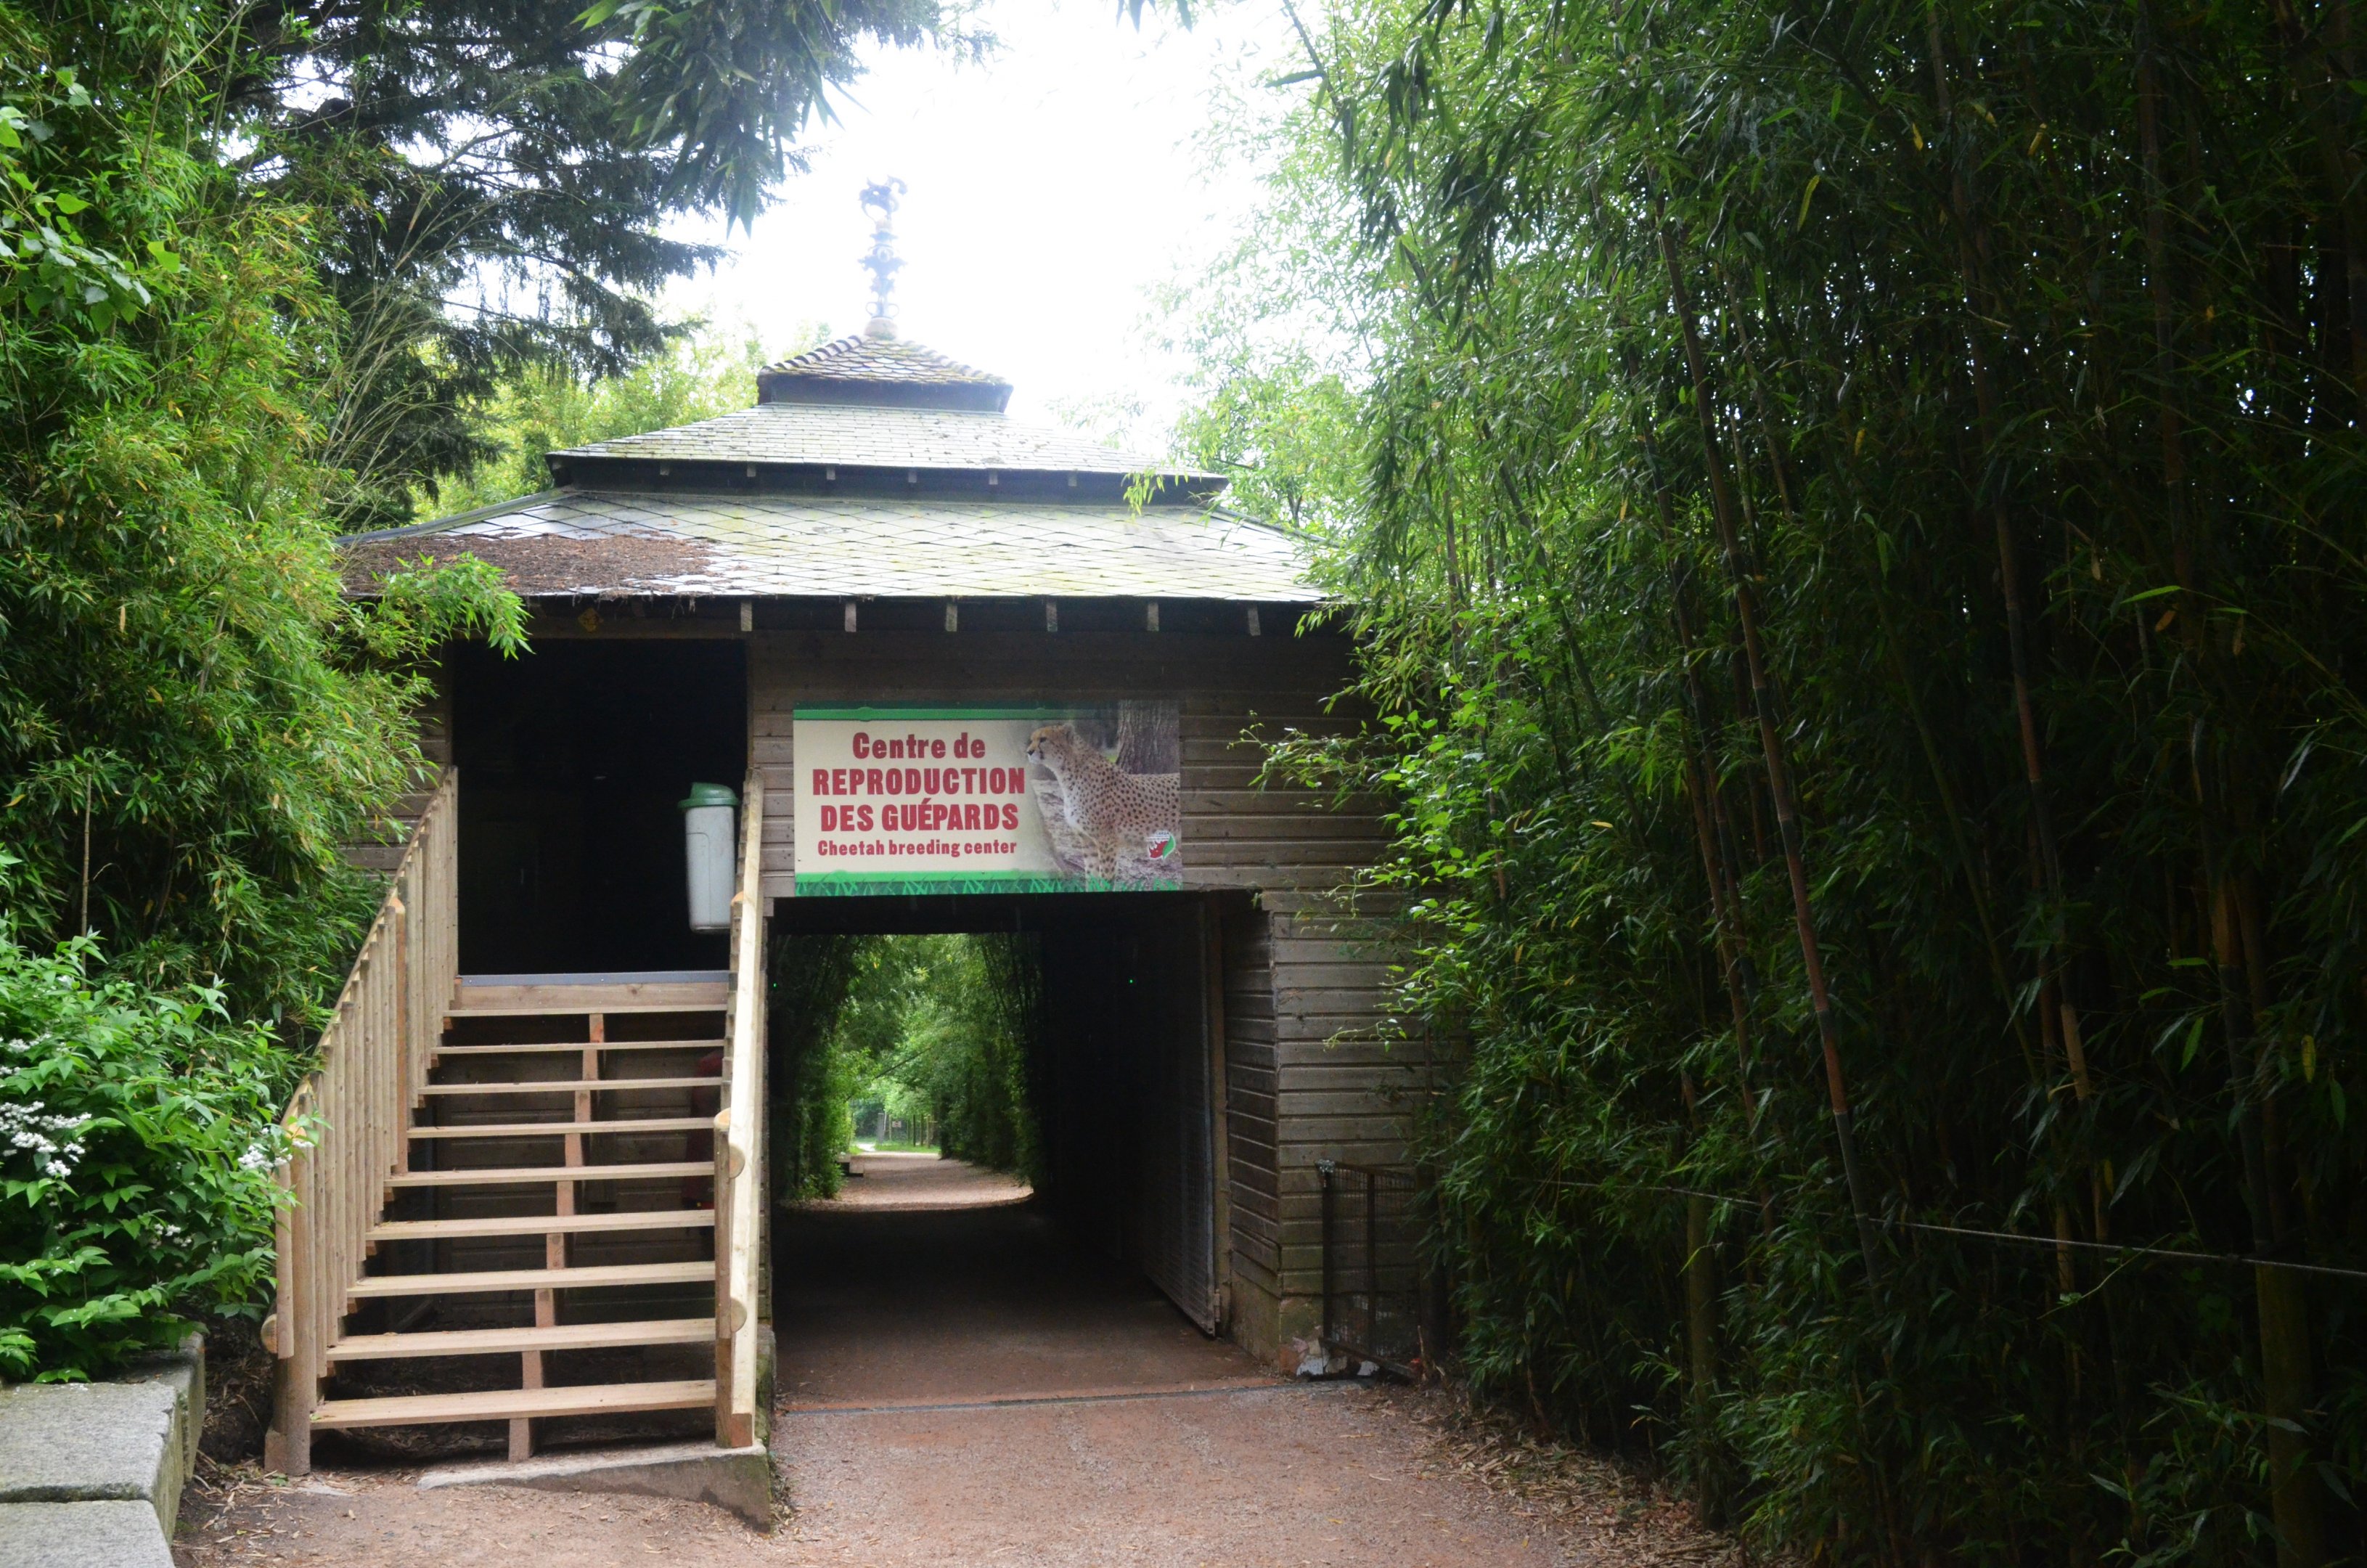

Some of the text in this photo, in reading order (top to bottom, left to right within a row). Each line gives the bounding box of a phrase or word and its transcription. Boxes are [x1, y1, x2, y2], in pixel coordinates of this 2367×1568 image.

[853, 732, 985, 759] Centre de
[812, 767, 1026, 796] REPRODUCTION
[820, 797, 1019, 833] DES GUÉPARDS
[817, 839, 1017, 858] Cheetah breeding center
